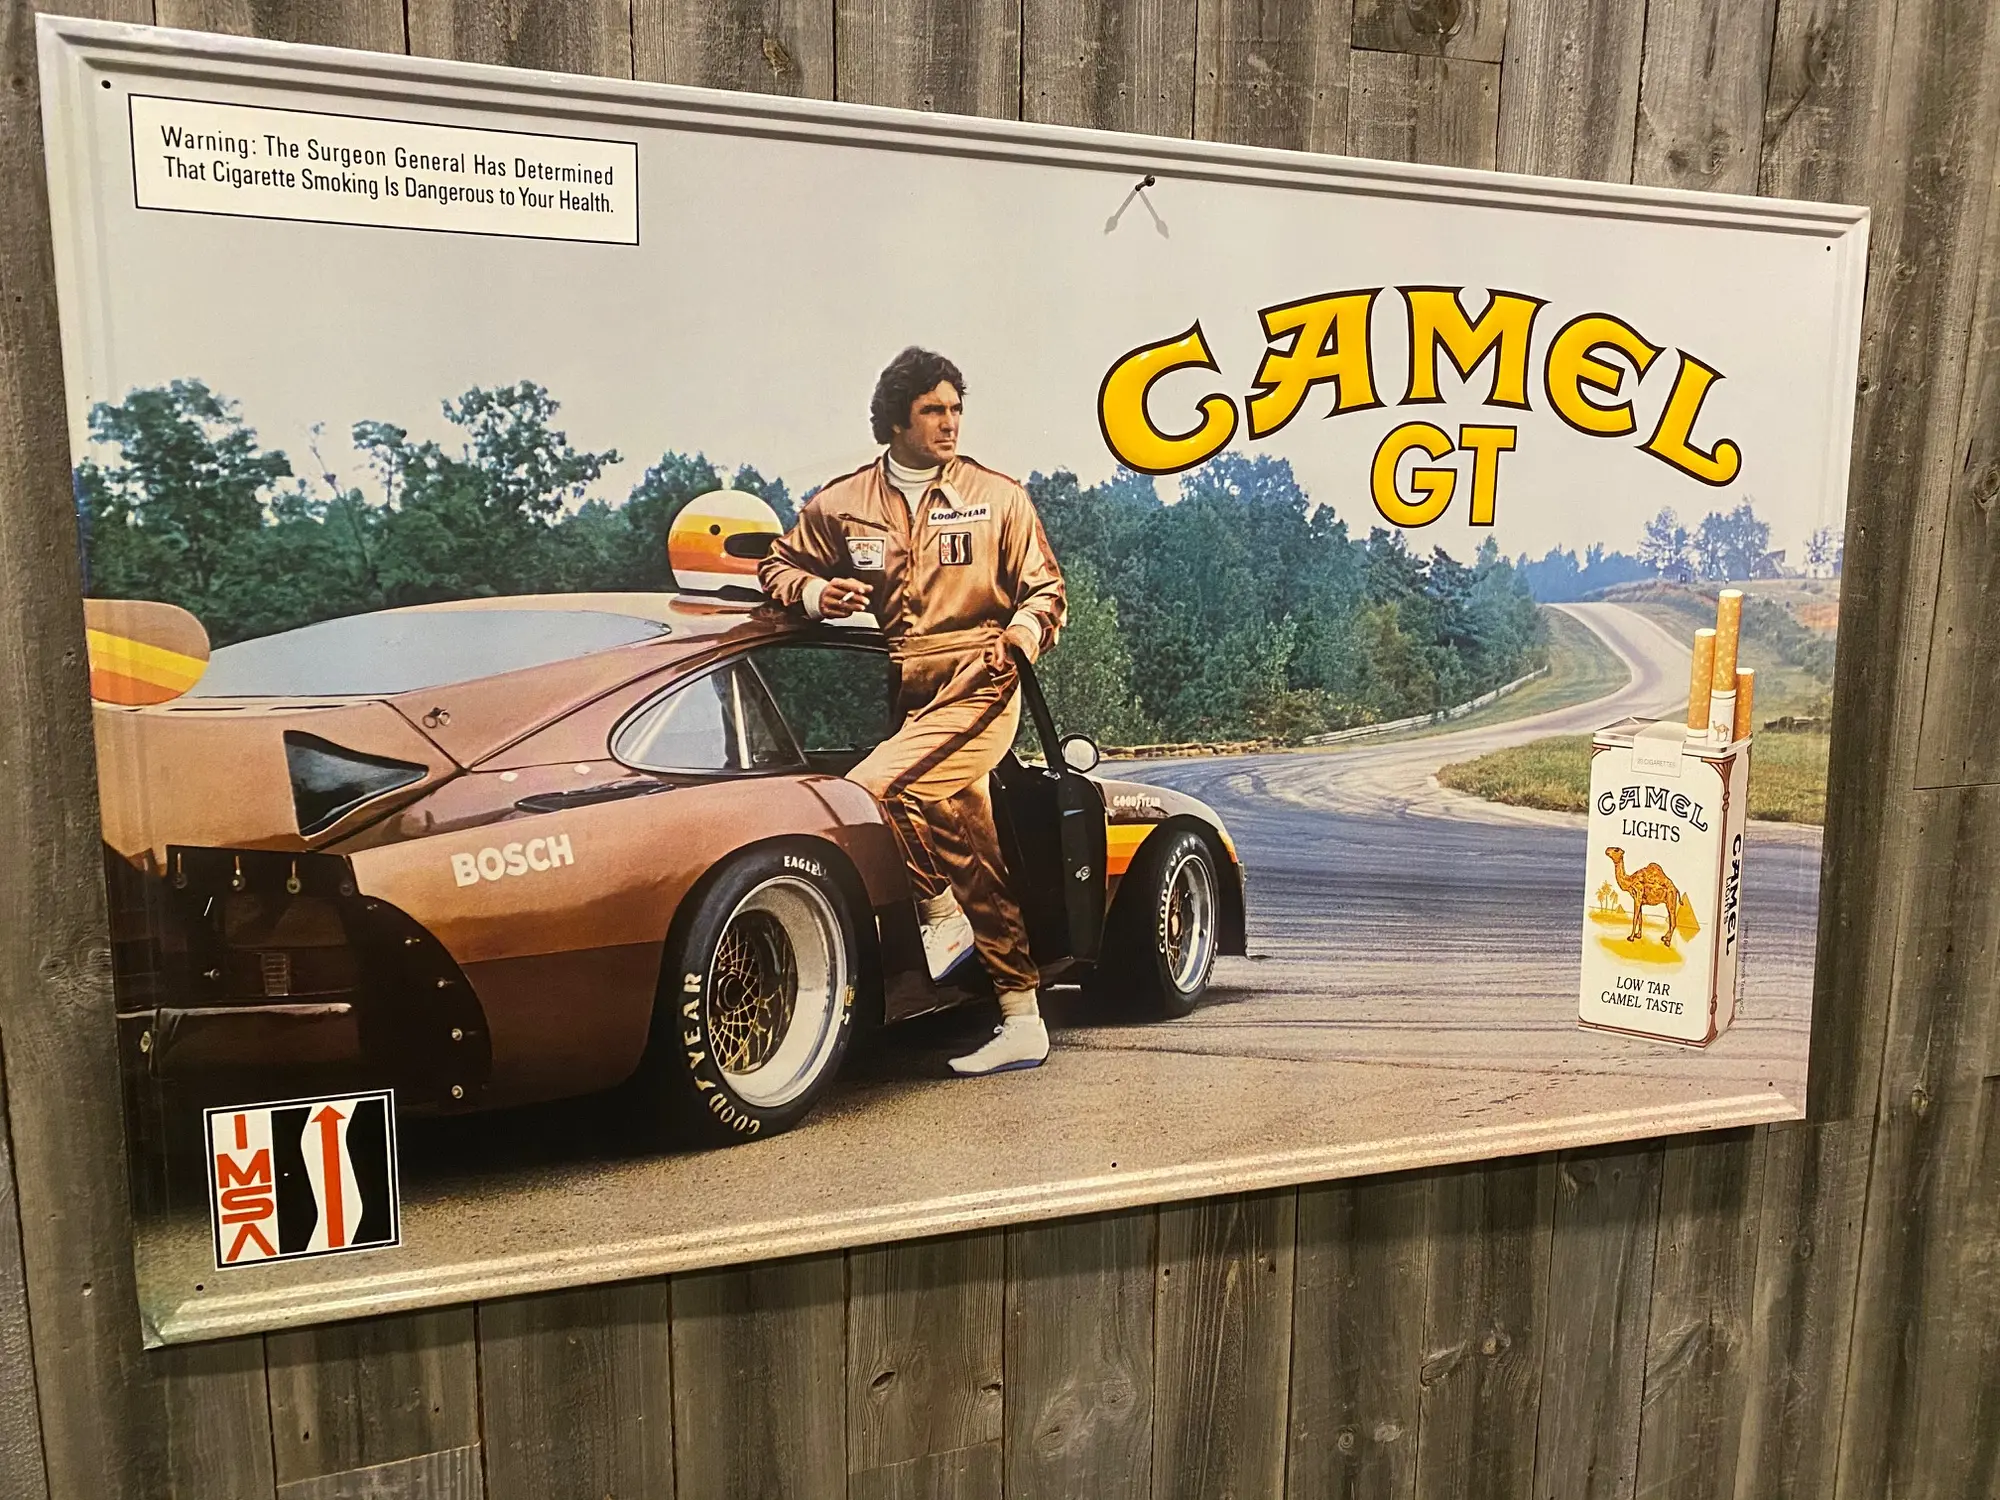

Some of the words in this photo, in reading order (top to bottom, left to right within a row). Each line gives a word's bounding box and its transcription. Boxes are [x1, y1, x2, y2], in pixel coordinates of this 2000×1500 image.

[161, 125, 257, 160] Warning:
[263, 134, 300, 159] The
[307, 139, 386, 169] Surgeon
[394, 146, 465, 174] General
[474, 153, 507, 177] Has
[514, 157, 613, 186] Determined
[162, 155, 206, 181] That
[212, 160, 296, 189] Cigarette
[301, 168, 379, 200] Smoking
[385, 175, 400, 197] Is
[405, 177, 495, 206] Dangerous
[499, 187, 515, 206] to
[518, 186, 555, 209] Your
[559, 189, 615, 214] Health.
[1097, 284, 1742, 488] CAMEL
[1371, 421, 1518, 529] GT
[1597, 785, 1708, 832] CAMEL
[1622, 818, 1681, 843] LIGHTS
[451, 833, 575, 888] BOSCH
[1725, 833, 1742, 956] CAMEL
[1601, 991, 1642, 1009] CAMEL
[1645, 997, 1684, 1015] TASTE
[1616, 976, 1645, 992] LOW
[1647, 981, 1671, 996] TAR
[215, 1113, 278, 1262] IMSA
